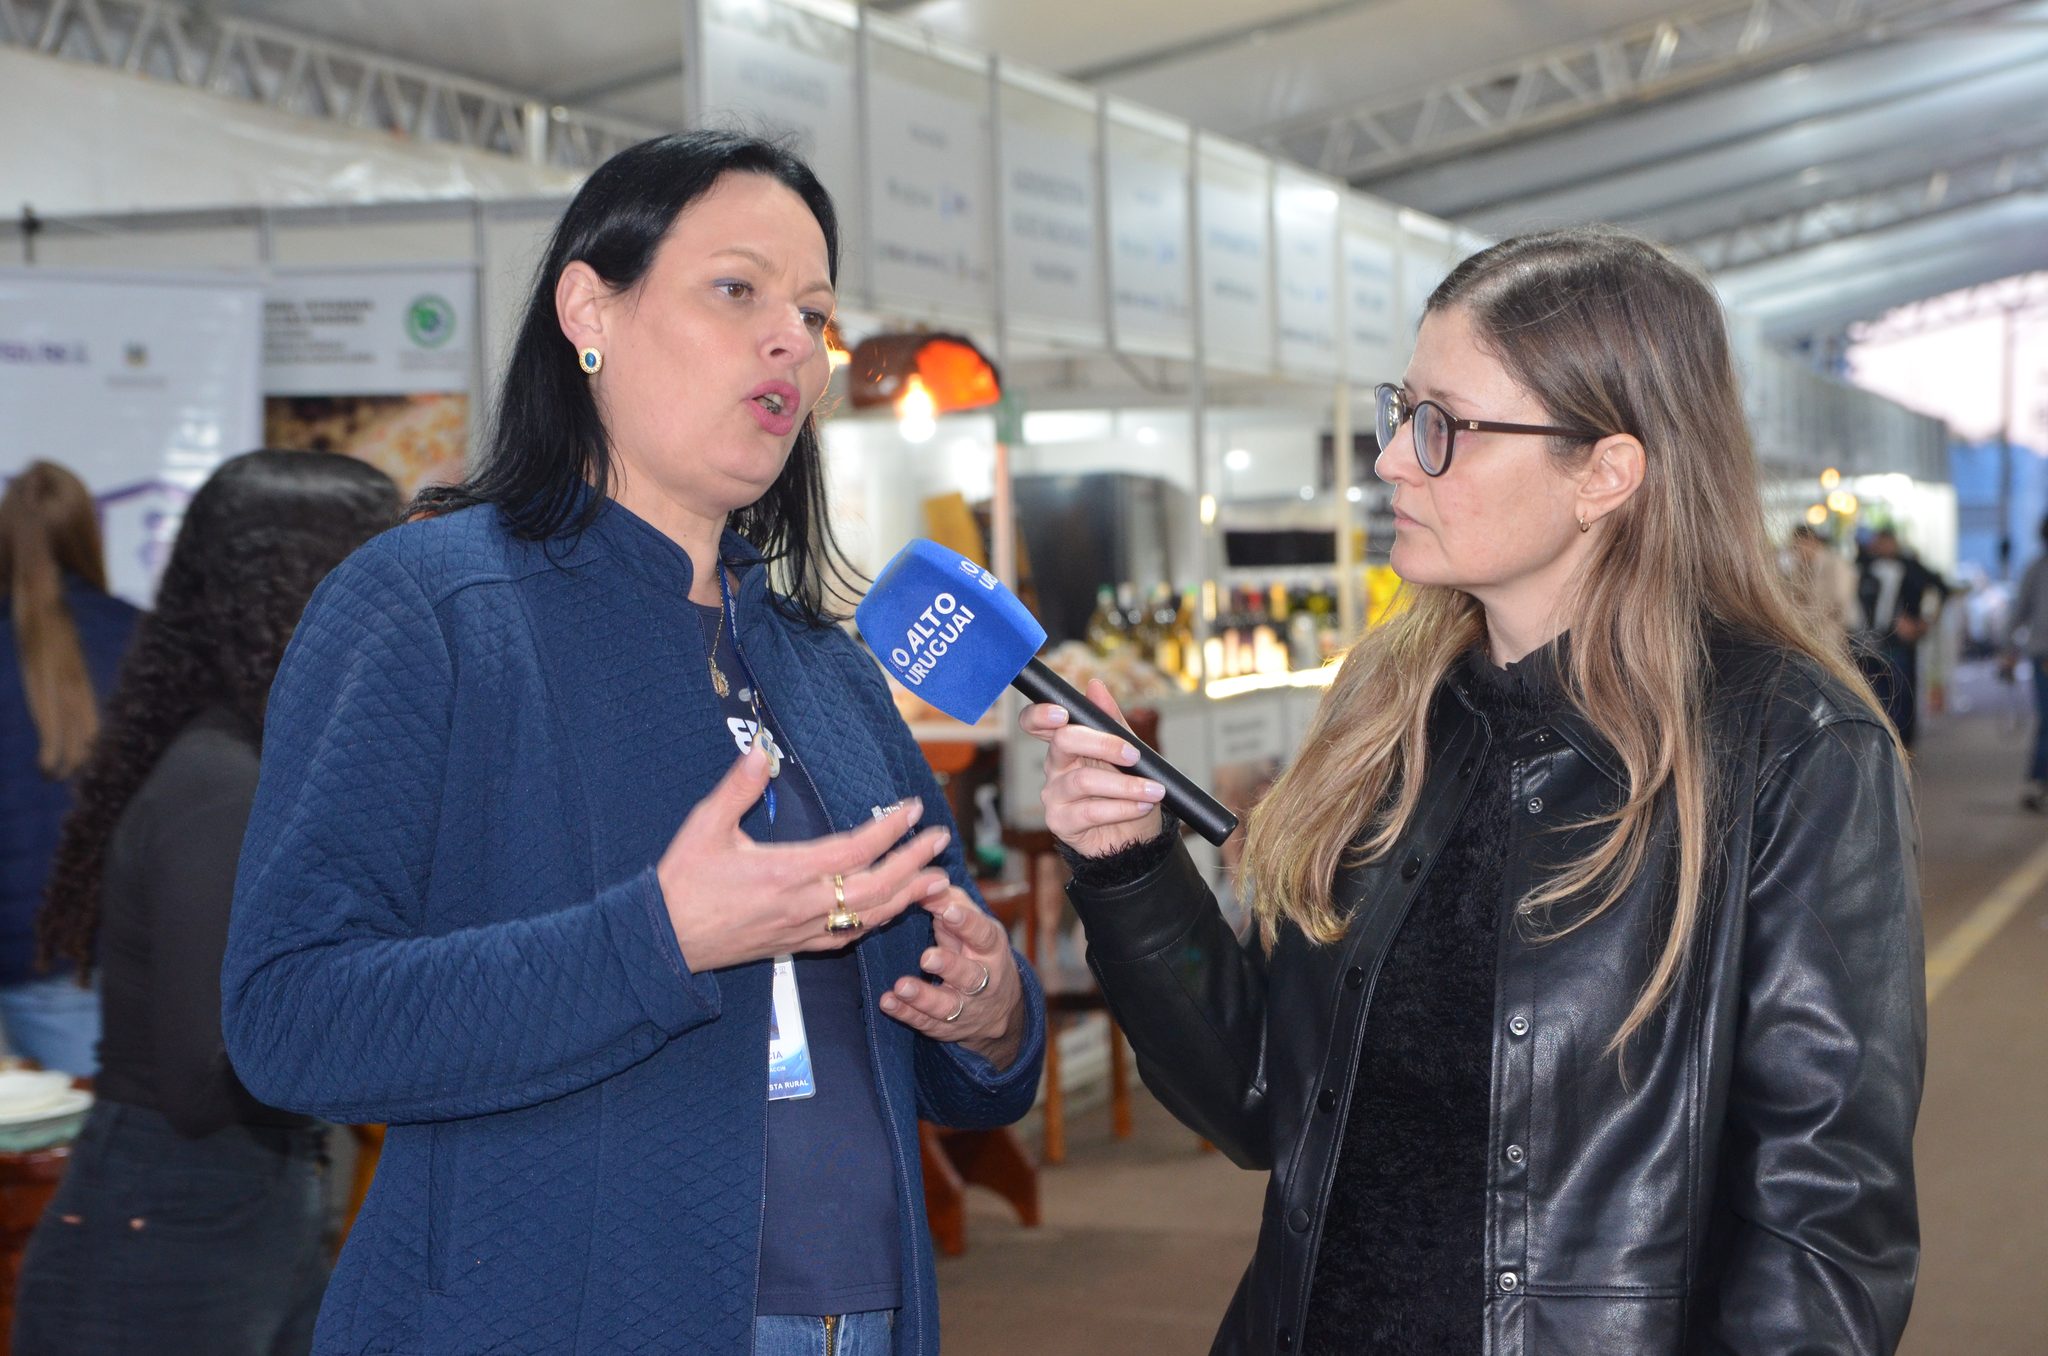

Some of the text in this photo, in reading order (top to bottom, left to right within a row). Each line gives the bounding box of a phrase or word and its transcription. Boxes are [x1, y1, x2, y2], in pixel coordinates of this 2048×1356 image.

[892, 648, 910, 667] O
[906, 592, 956, 655] ALTO
[904, 604, 976, 686] URUGUAI
[784, 1079, 809, 1088] RURAL
